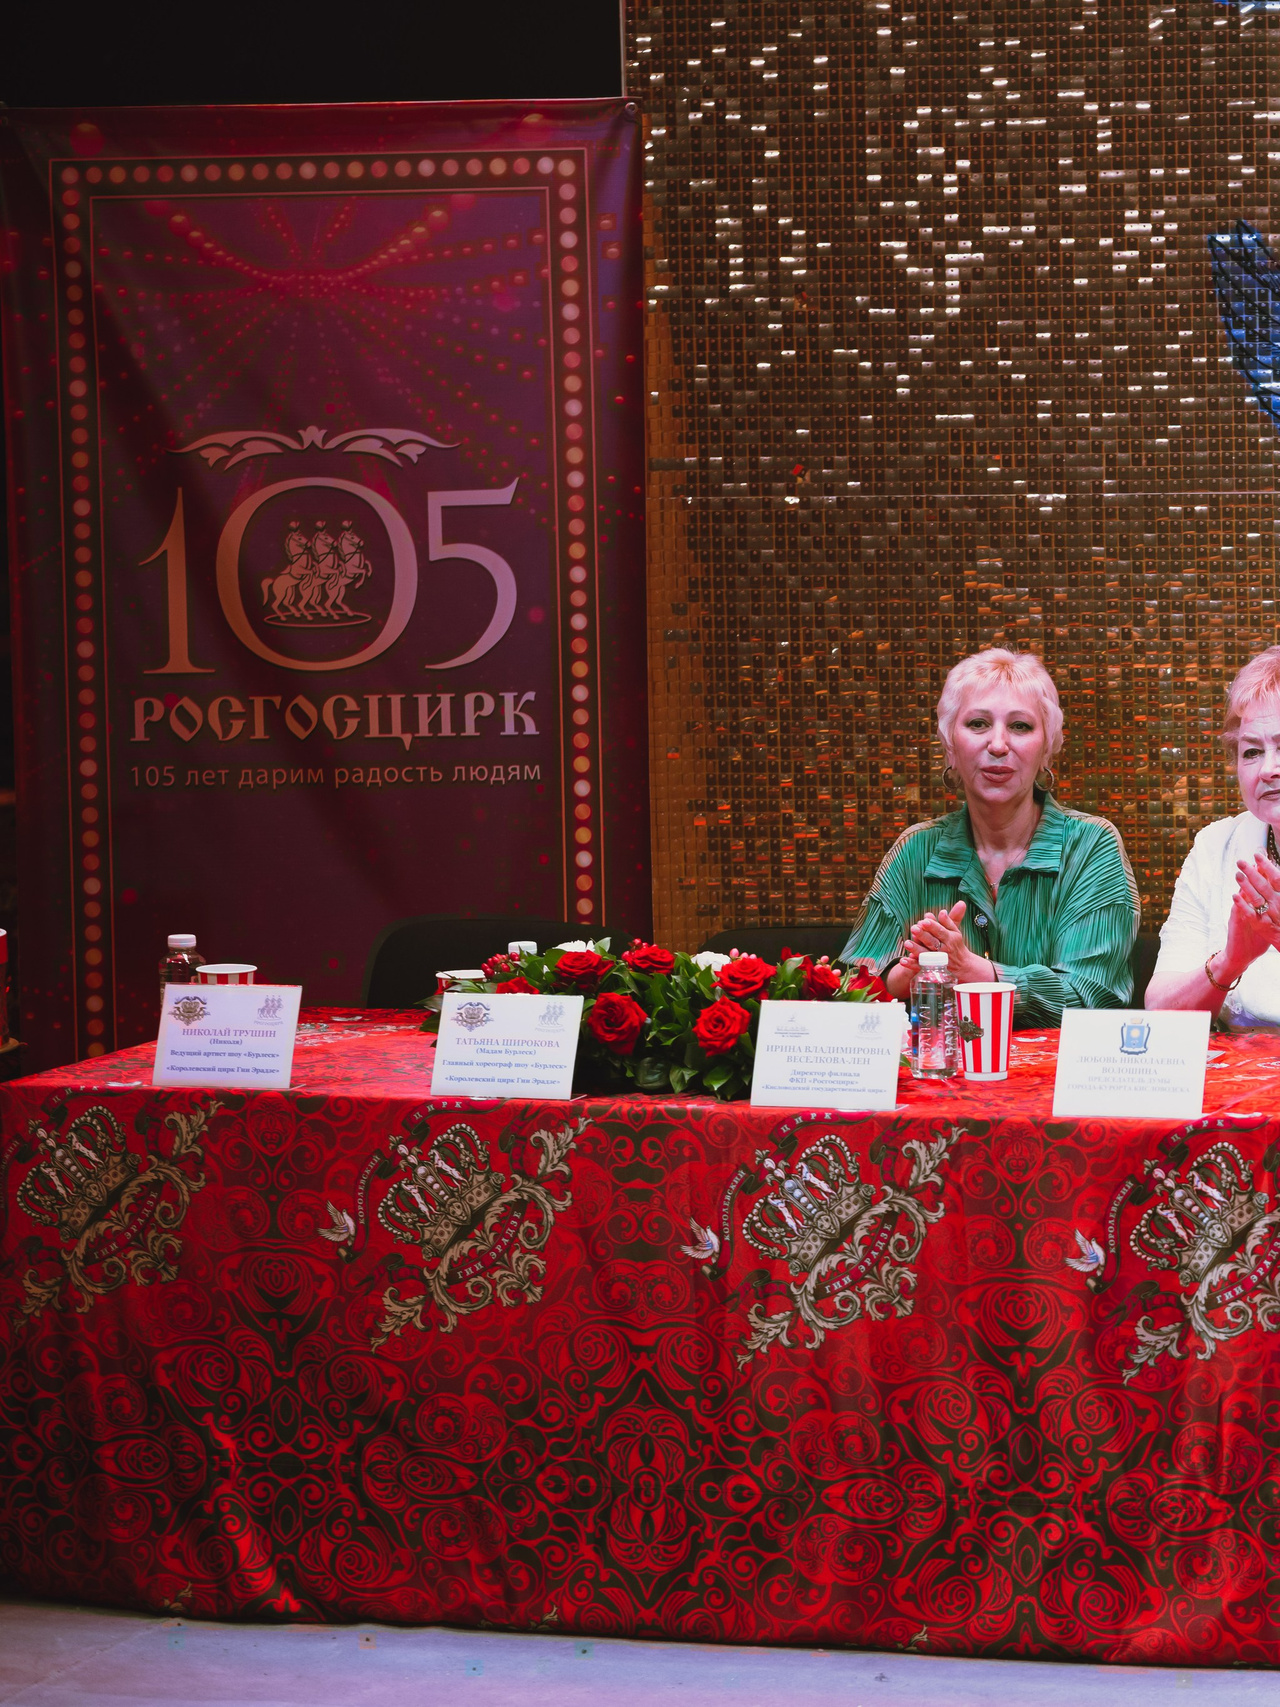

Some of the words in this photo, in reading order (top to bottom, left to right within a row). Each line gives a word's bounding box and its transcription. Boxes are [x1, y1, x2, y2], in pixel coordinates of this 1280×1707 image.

[130, 690, 540, 751] РОСГОСЦИРК
[131, 766, 175, 788] 105
[186, 768, 229, 787] лет
[238, 768, 325, 789] дарим
[334, 768, 443, 790] радость
[452, 763, 541, 785] людям
[182, 1027, 230, 1037] НИКОЛАЙ
[233, 1029, 276, 1038] ТРУШИН
[456, 1037, 500, 1046] ТАТЬЯНА
[502, 1038, 560, 1047] ШИРОКОВА
[170, 1049, 201, 1057] Ведущий
[766, 1044, 802, 1053] ИРИНА
[804, 1046, 891, 1055] ВЛАДИМИРОВНА
[475, 1060, 513, 1068] хореограф
[786, 1056, 870, 1065] ВЕСЕЛКОВА-ЛЕН
[1076, 1055, 1118, 1064] ЛЮБОВЬ
[1120, 1056, 1186, 1066] НИКОЛАЕВНА
[167, 1065, 216, 1073] «Королевский
[790, 1069, 826, 1077] Директор
[1101, 1067, 1158, 1075] ВОЛОШИНА
[445, 1075, 496, 1083] «Королевский
[457, 1261, 484, 1280] ГИИ
[489, 1210, 522, 1260] ЭРАДЗЕ
[825, 1275, 853, 1294] ГИИ
[858, 1223, 893, 1273] ЭРАДЗЕ
[1216, 1285, 1244, 1304] ГИИ
